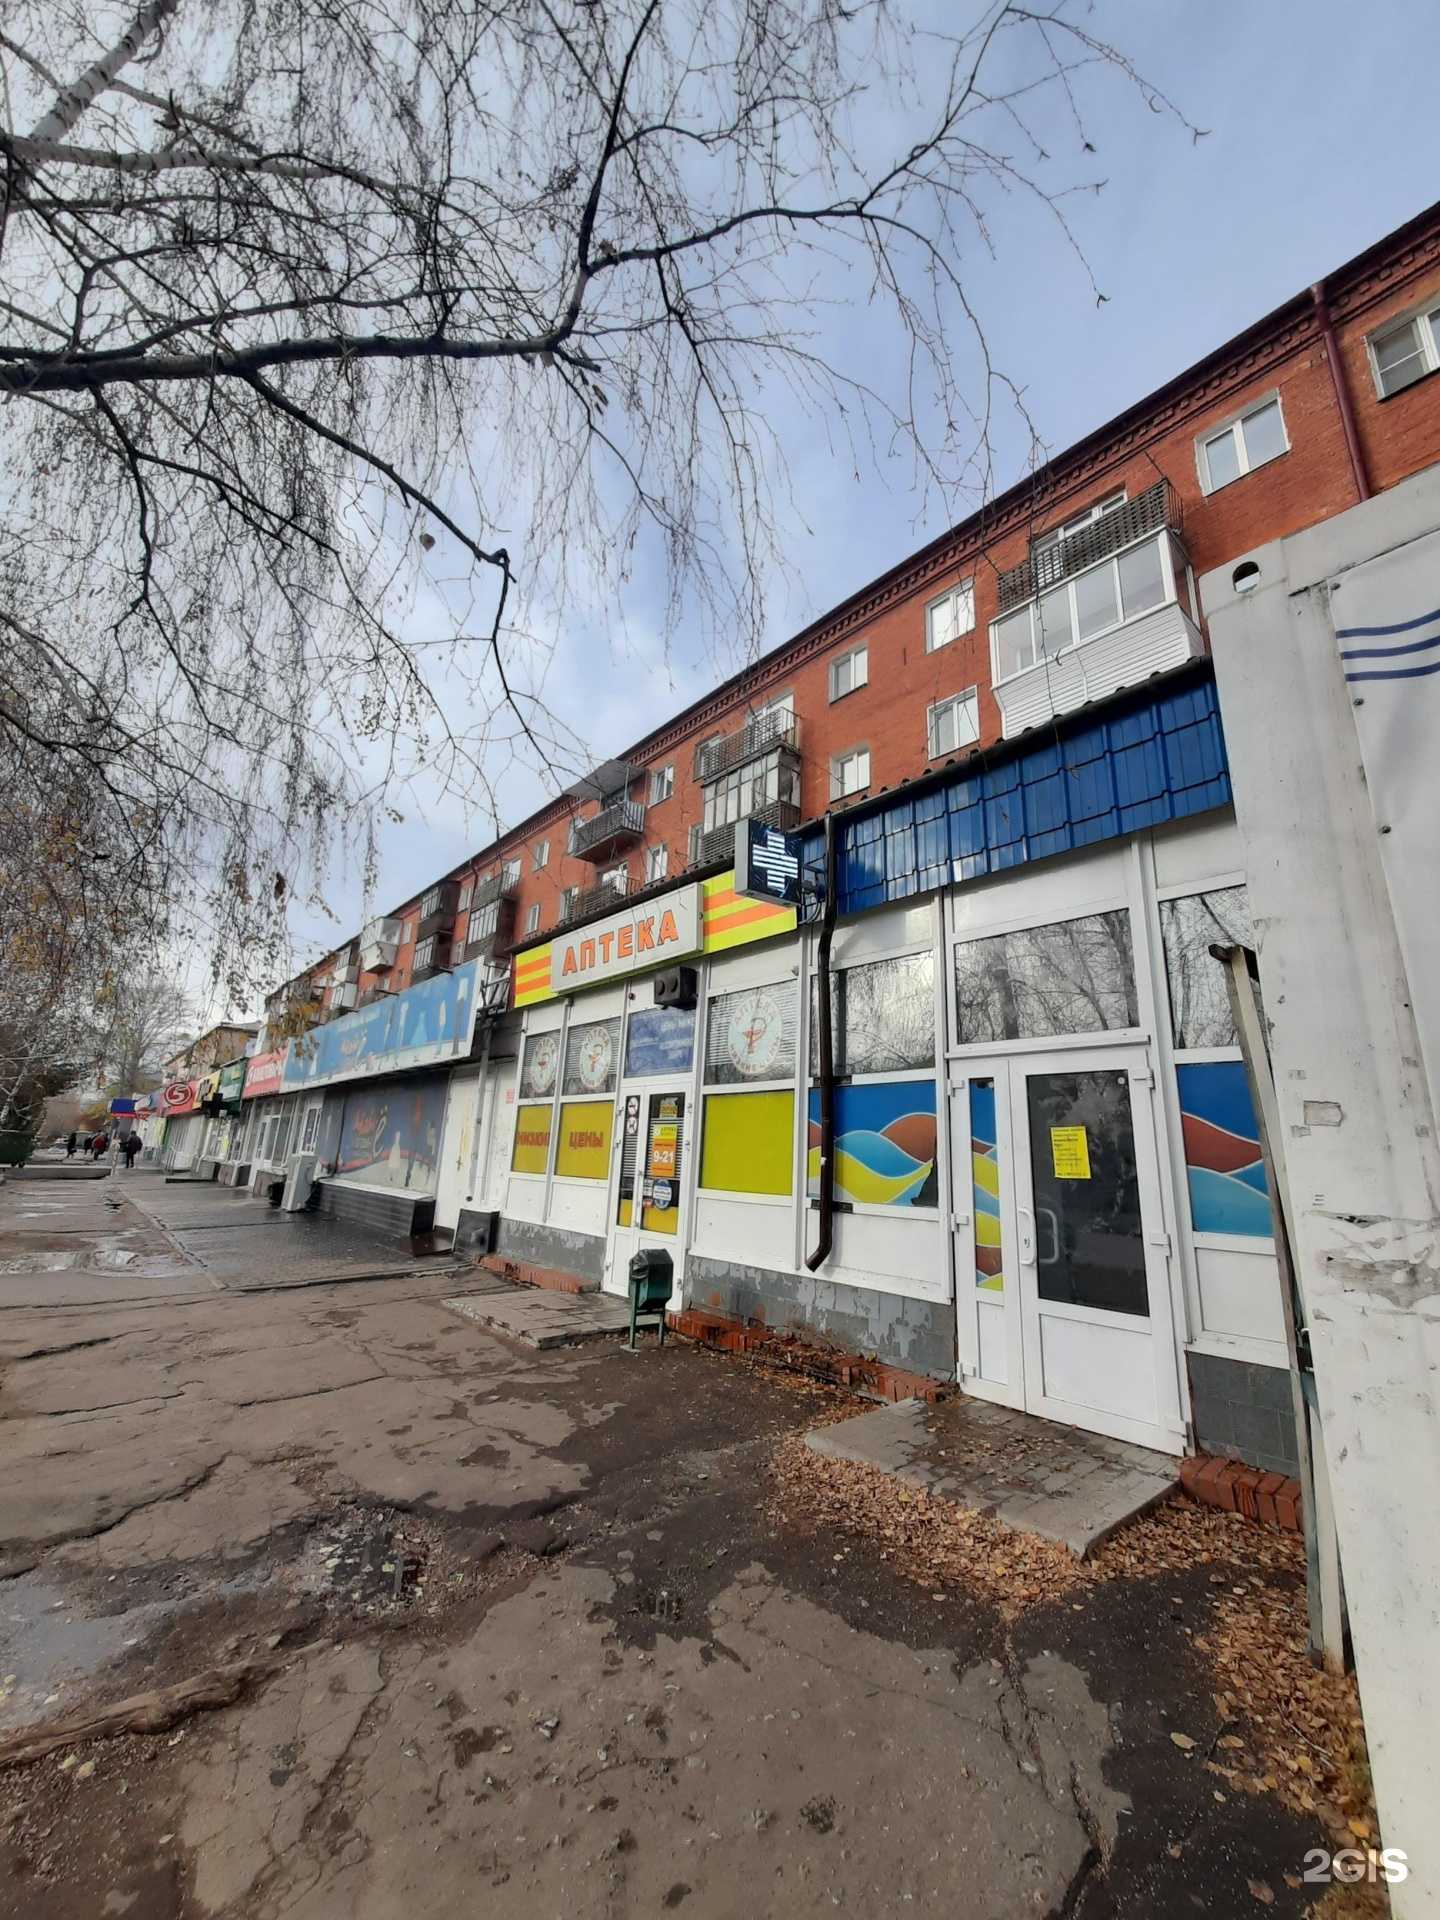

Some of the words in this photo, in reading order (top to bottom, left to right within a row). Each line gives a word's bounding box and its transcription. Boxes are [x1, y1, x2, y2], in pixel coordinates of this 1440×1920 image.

[562, 909, 679, 976] АПТЕКА
[569, 1131, 604, 1149] ЦЕНЫ
[653, 1150, 674, 1163] 9-21
